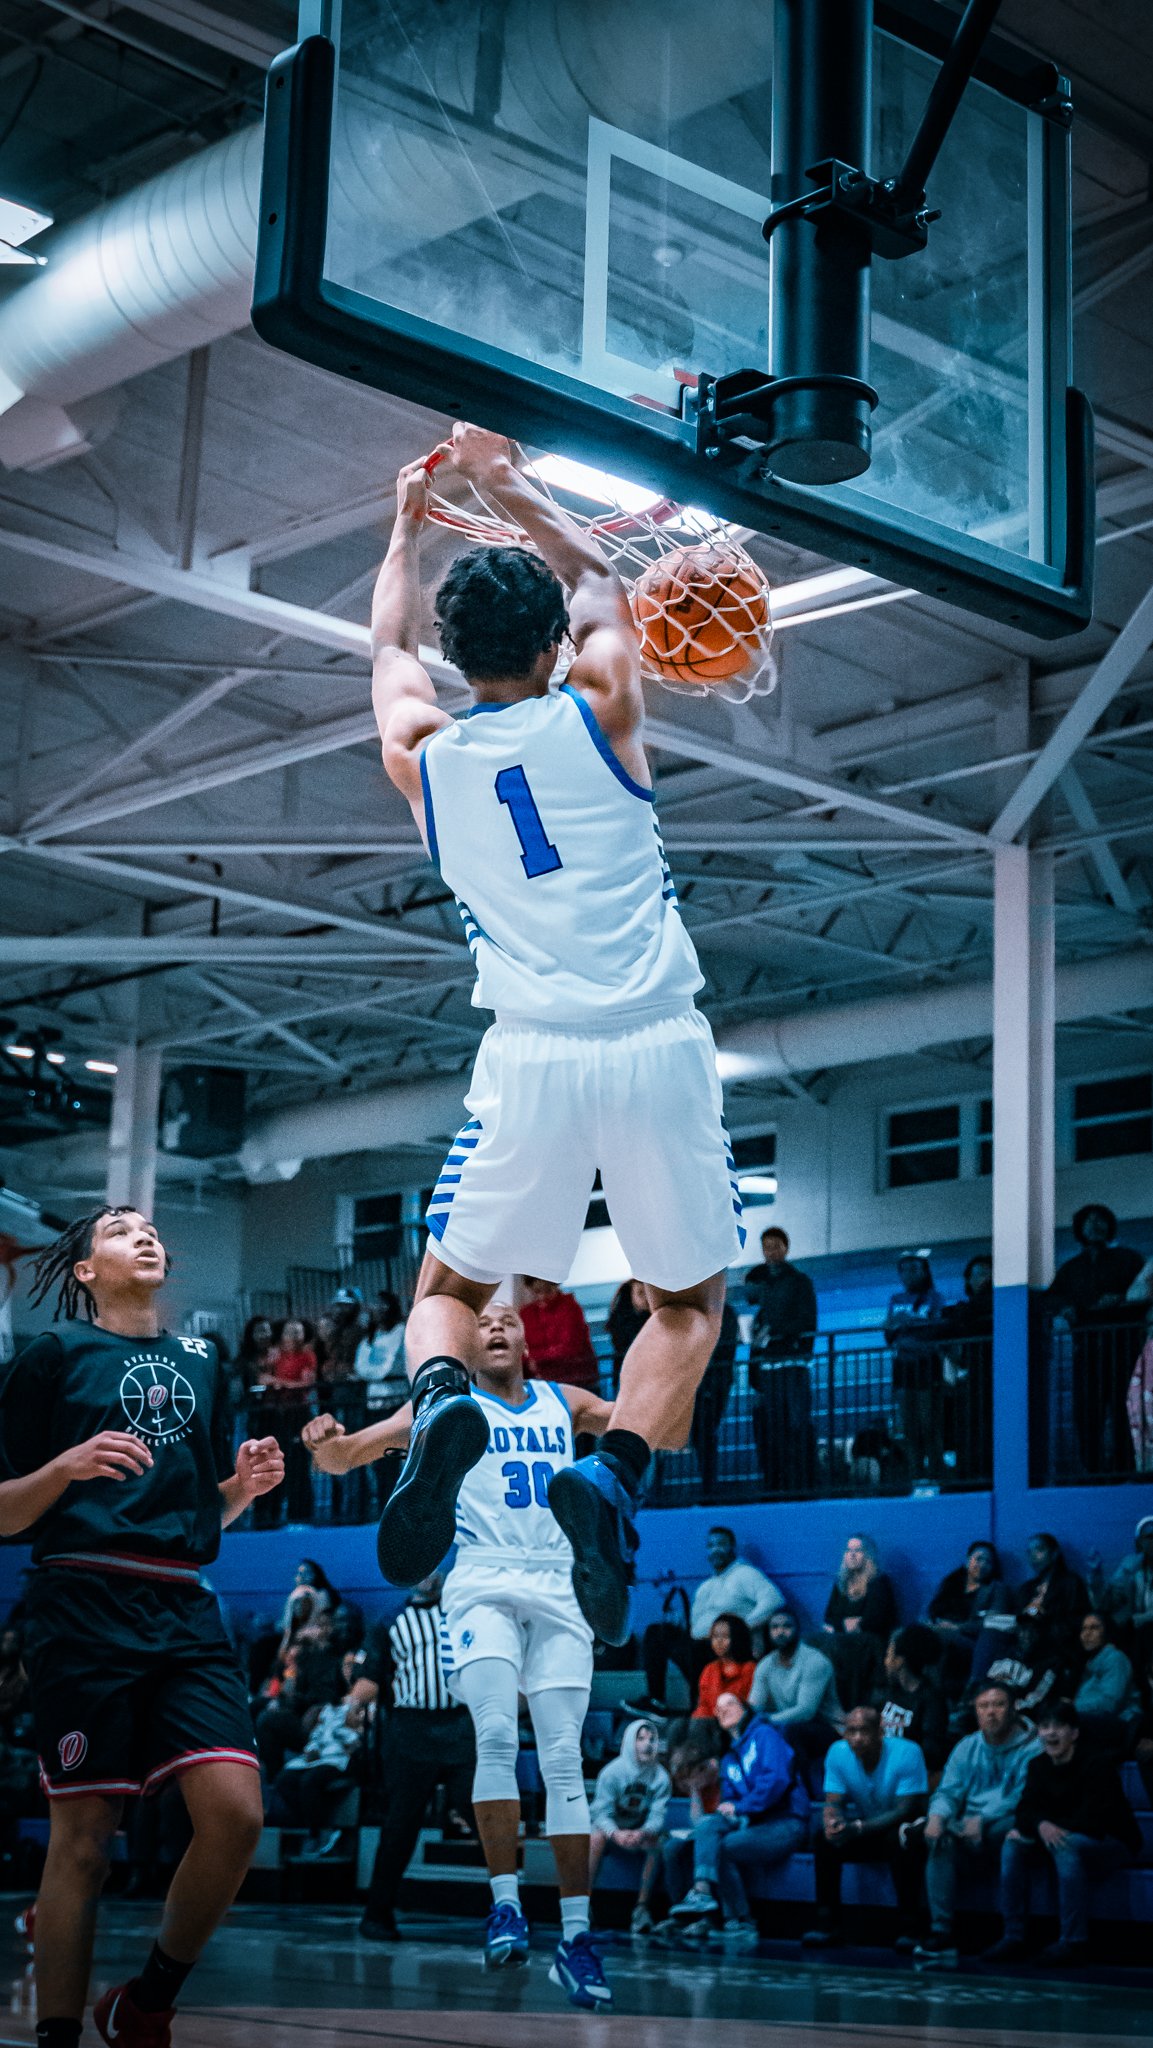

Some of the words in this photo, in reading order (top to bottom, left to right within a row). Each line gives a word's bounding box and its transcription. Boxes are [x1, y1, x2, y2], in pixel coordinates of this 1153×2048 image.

[494, 764, 563, 880] 1
[123, 1354, 176, 1367] OVERTON
[177, 1336, 208, 1358] 22
[486, 1426, 565, 1454] OYALS
[501, 1461, 554, 1509] 30
